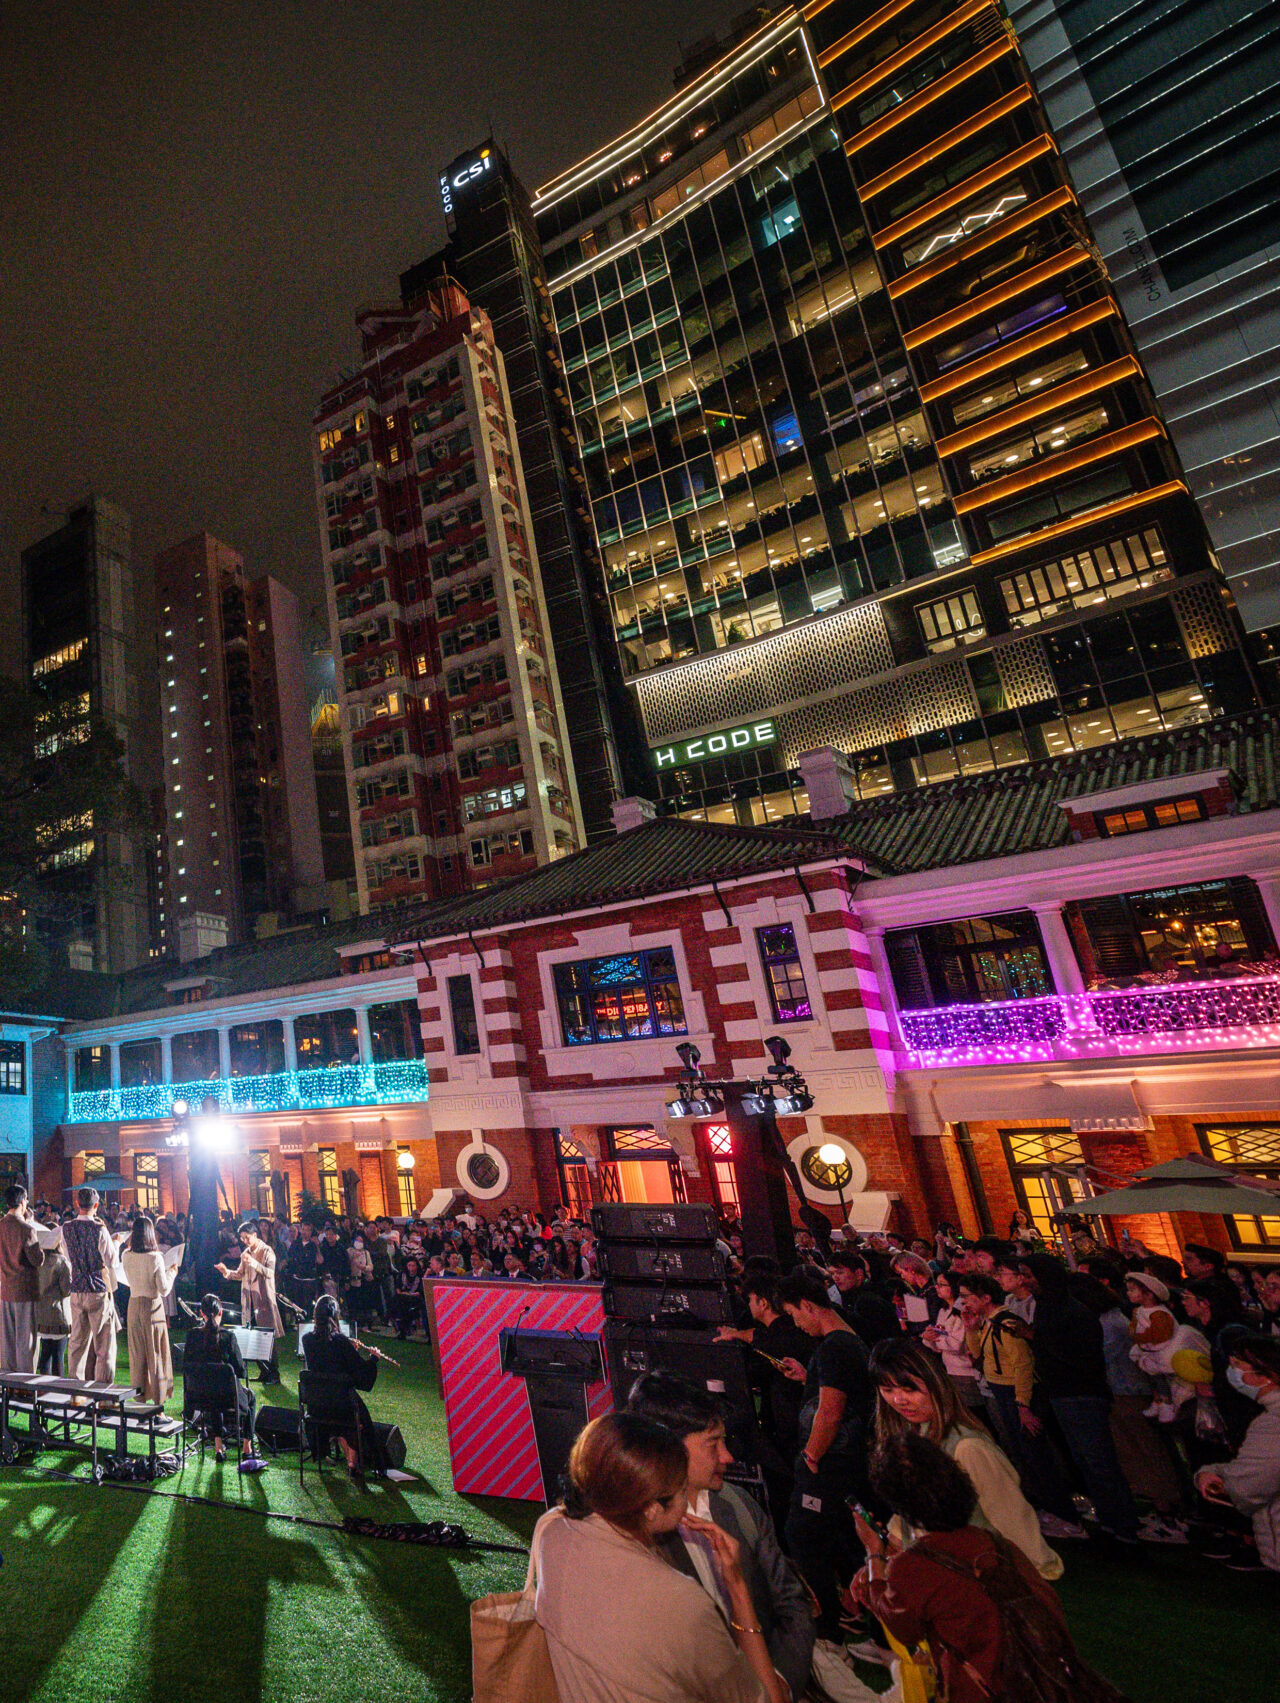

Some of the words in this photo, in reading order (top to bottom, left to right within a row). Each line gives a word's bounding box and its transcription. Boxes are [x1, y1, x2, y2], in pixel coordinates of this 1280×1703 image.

[440, 176, 453, 213] FOCO
[656, 748, 675, 766] H
[686, 723, 774, 758] CODE
